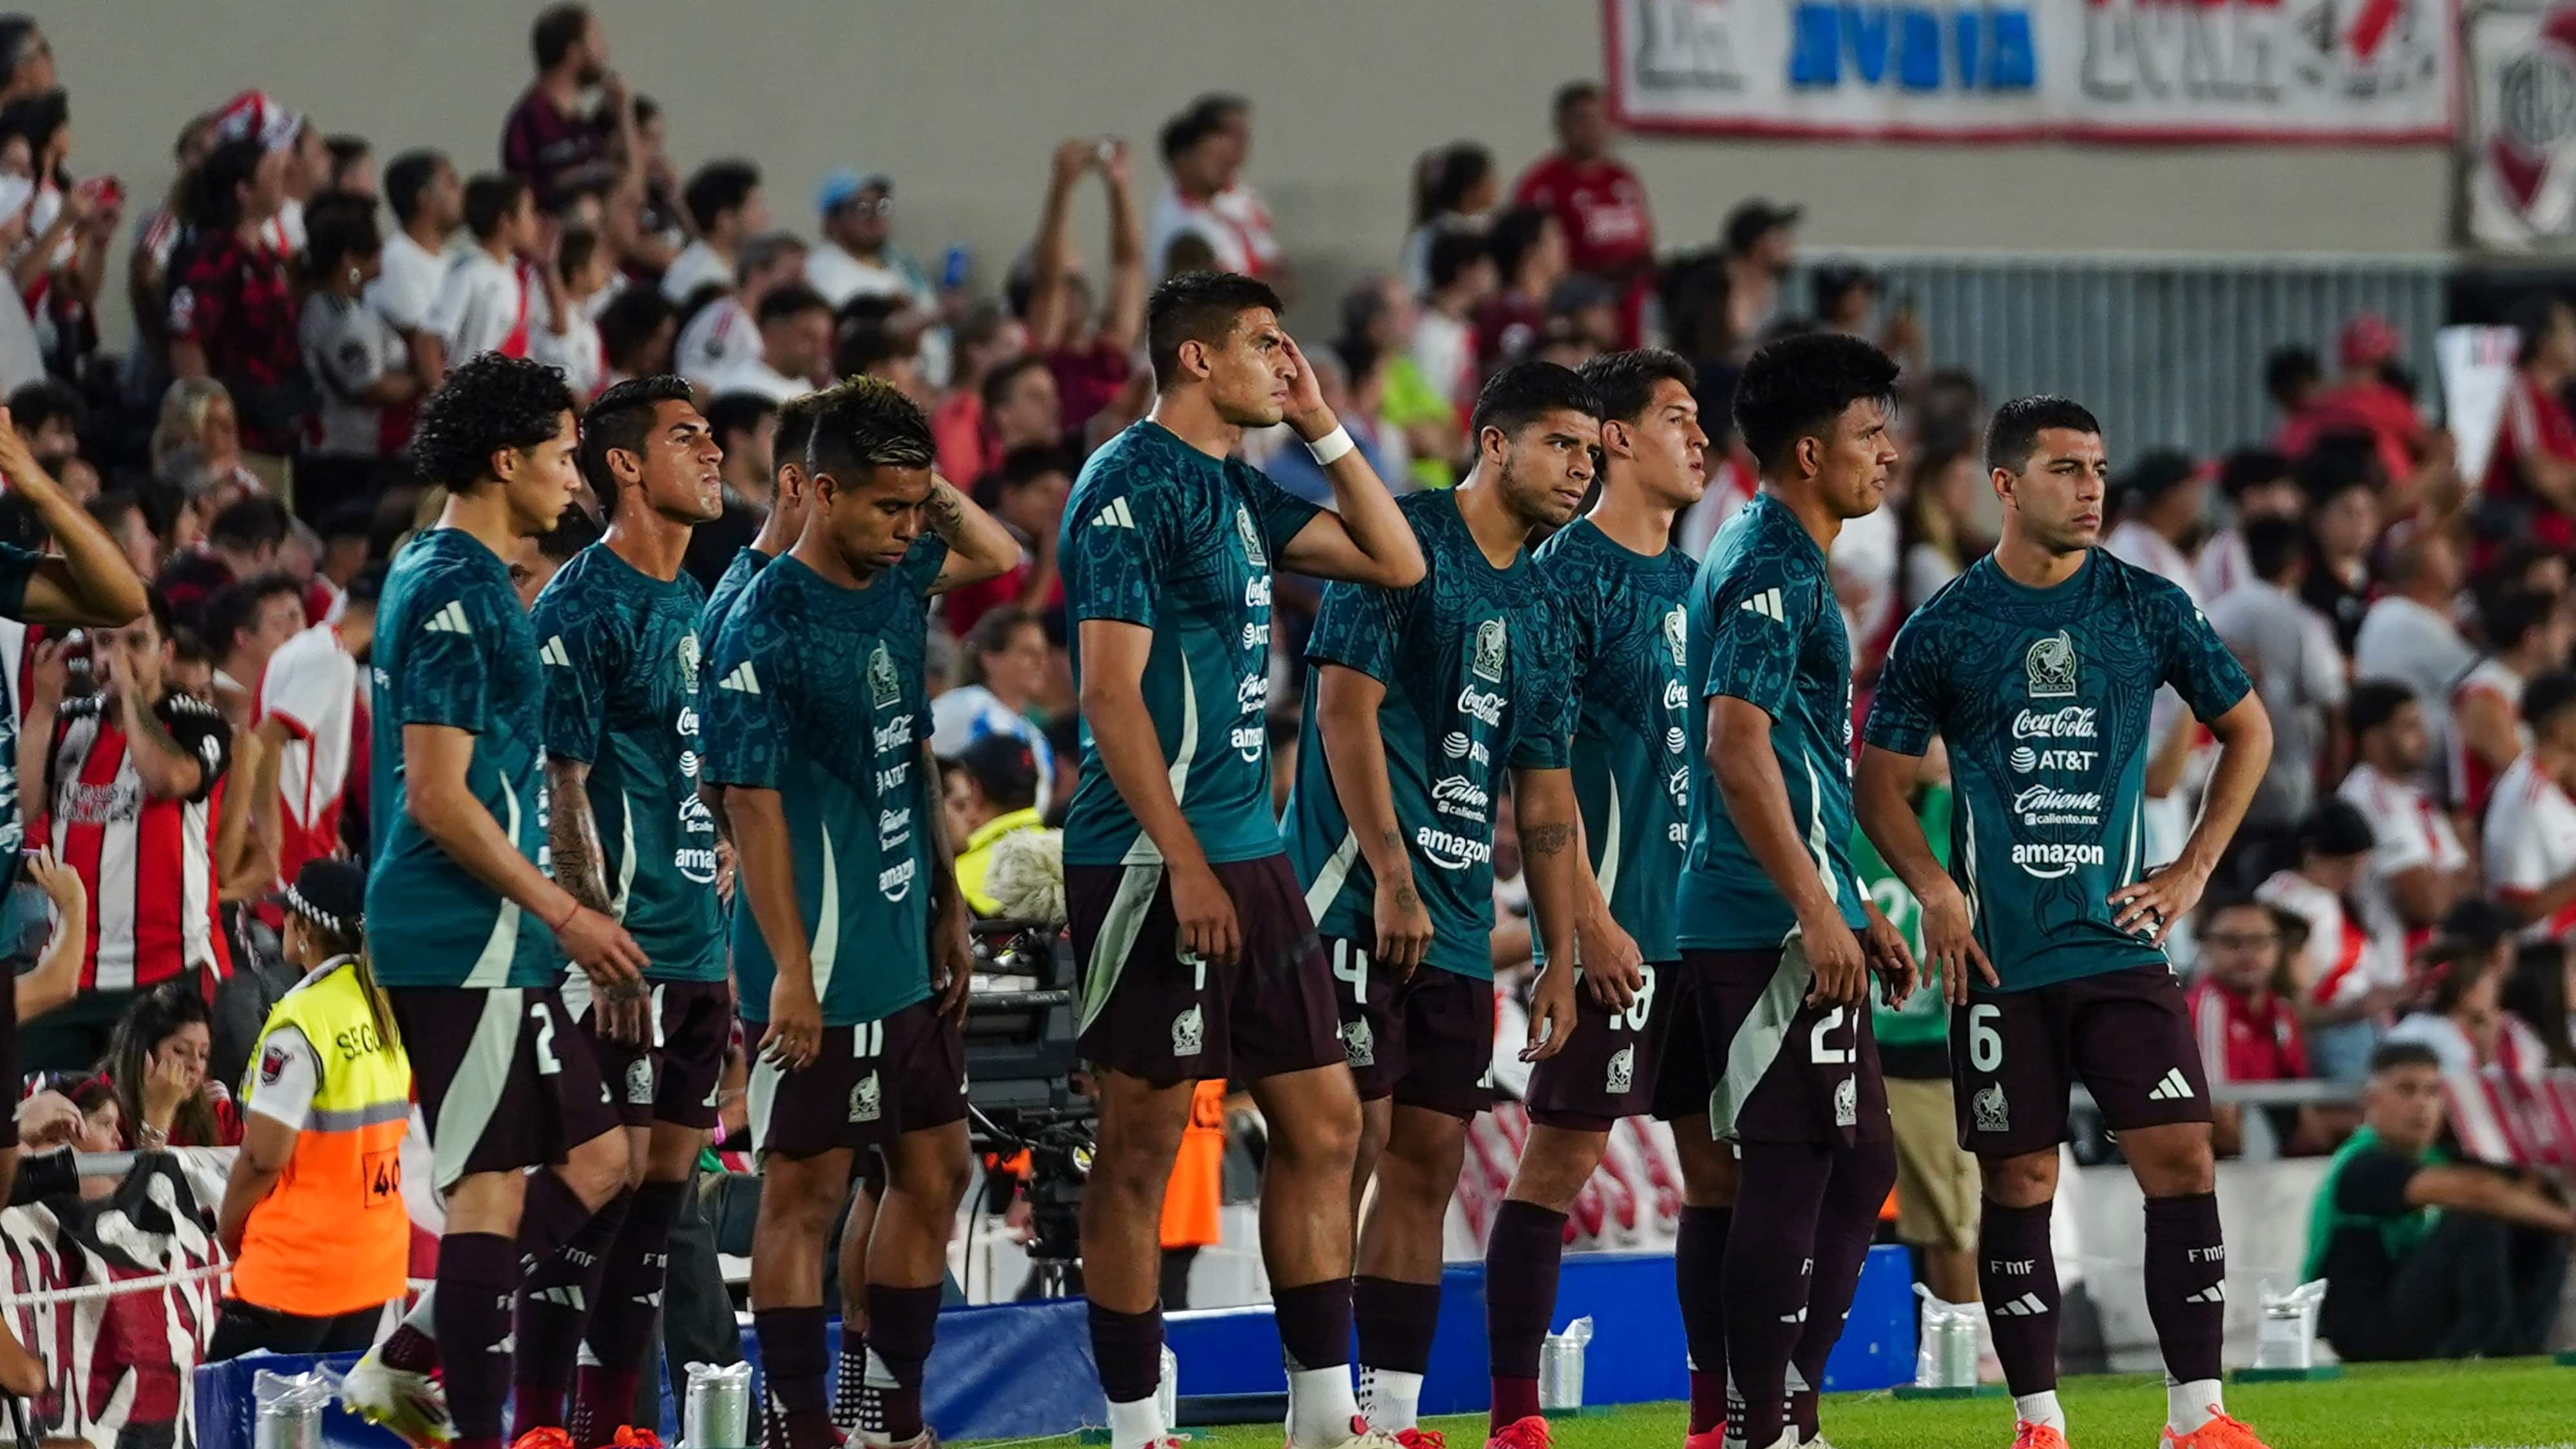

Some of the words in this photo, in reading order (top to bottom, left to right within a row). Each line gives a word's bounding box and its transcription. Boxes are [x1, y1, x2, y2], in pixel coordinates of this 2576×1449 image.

[2012, 706, 2098, 739] Coca-Cola
[2038, 750, 2098, 771] AT&T
[2014, 784, 2101, 814] Caliente
[2036, 813, 2098, 825] caliente.mx
[1417, 826, 1491, 864] amazon
[2012, 844, 2104, 866] amazon
[1333, 938, 1368, 1005] 4
[1969, 1004, 2003, 1072] 6
[1991, 1260, 2035, 1275] FMF
